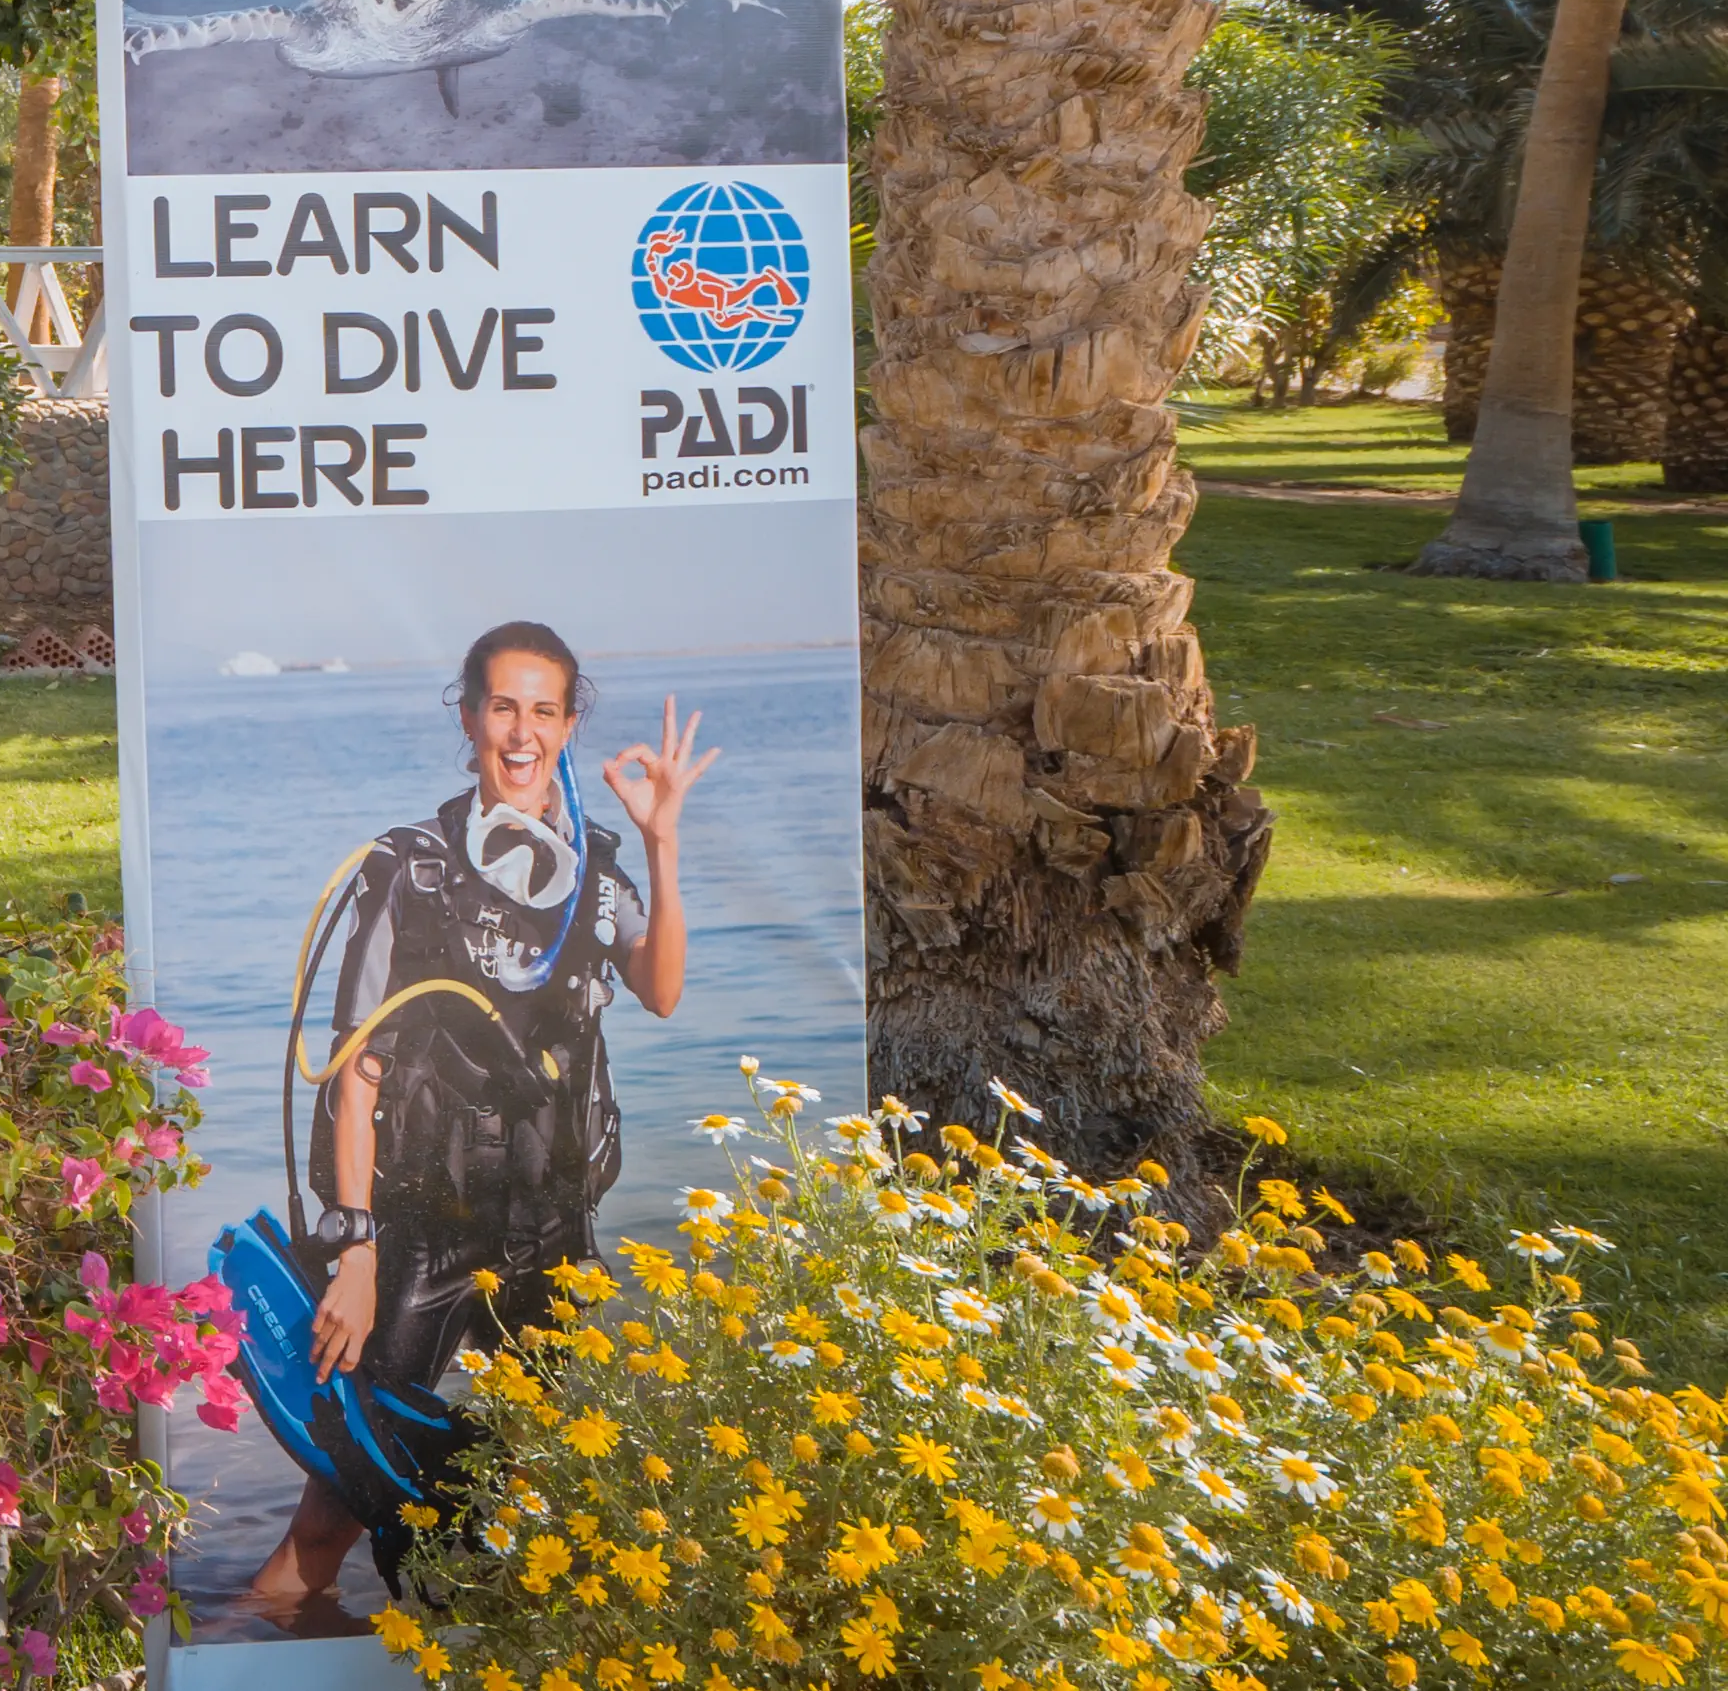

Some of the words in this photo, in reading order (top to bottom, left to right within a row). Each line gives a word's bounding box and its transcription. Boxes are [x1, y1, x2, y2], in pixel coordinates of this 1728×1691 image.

[153, 189, 499, 280] LEARN
[129, 311, 284, 399] TO
[323, 307, 558, 396] DIVE
[641, 384, 808, 459] PADI
[162, 422, 430, 511] HERE
[642, 461, 810, 497] padi.com
[247, 1284, 297, 1360] CRESSI
